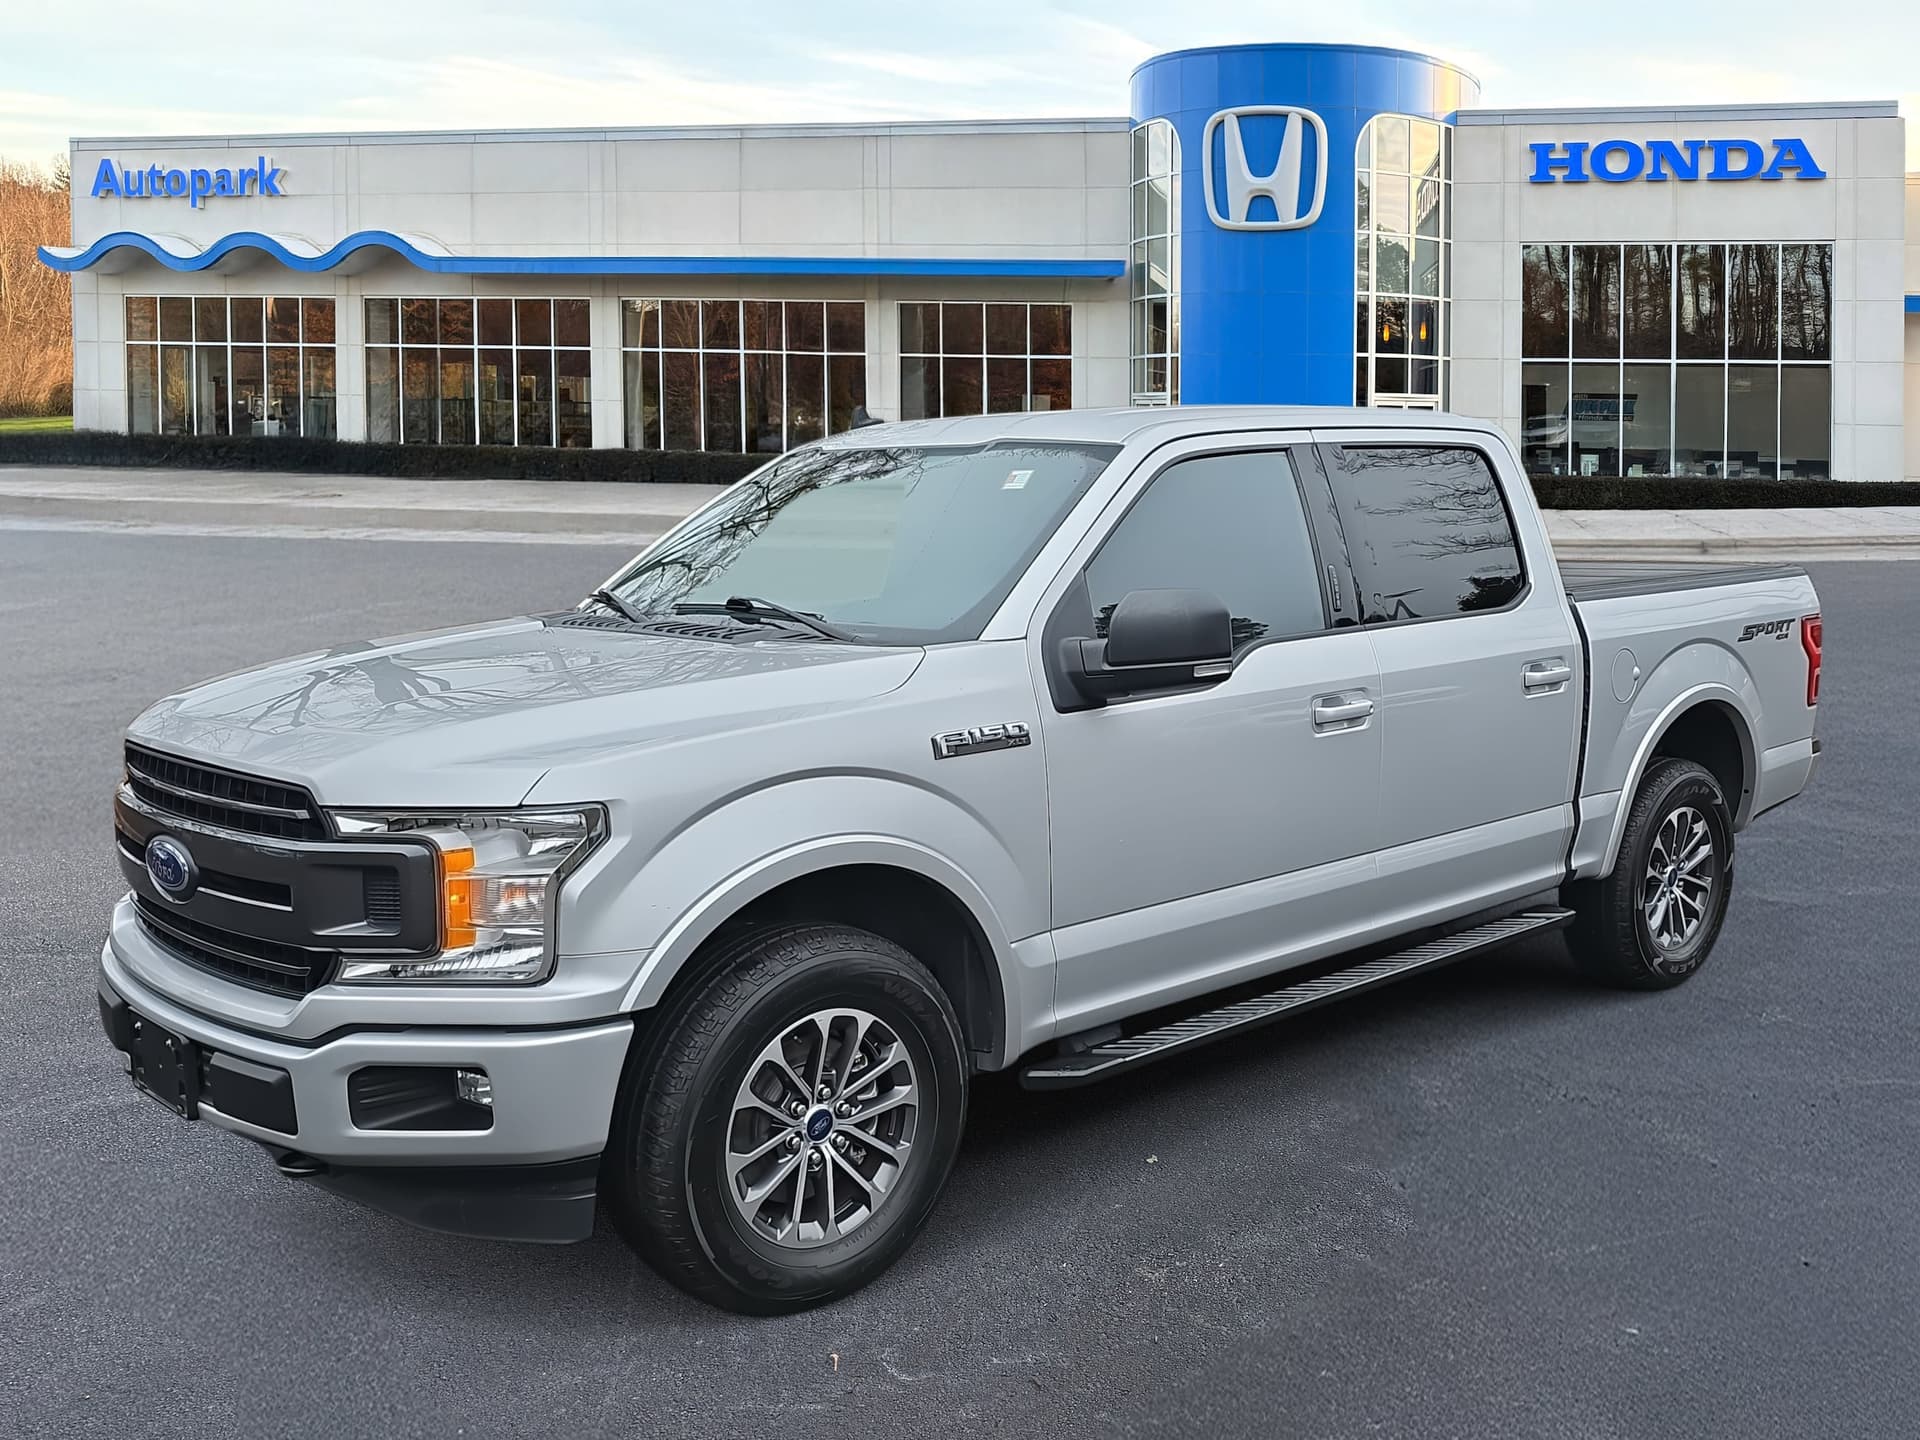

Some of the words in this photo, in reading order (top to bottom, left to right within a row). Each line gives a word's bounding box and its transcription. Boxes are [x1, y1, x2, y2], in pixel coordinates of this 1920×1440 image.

[91, 155, 284, 210] Autopark
[1529, 137, 1828, 183] HONDA
[1737, 618, 1796, 642] SPORT
